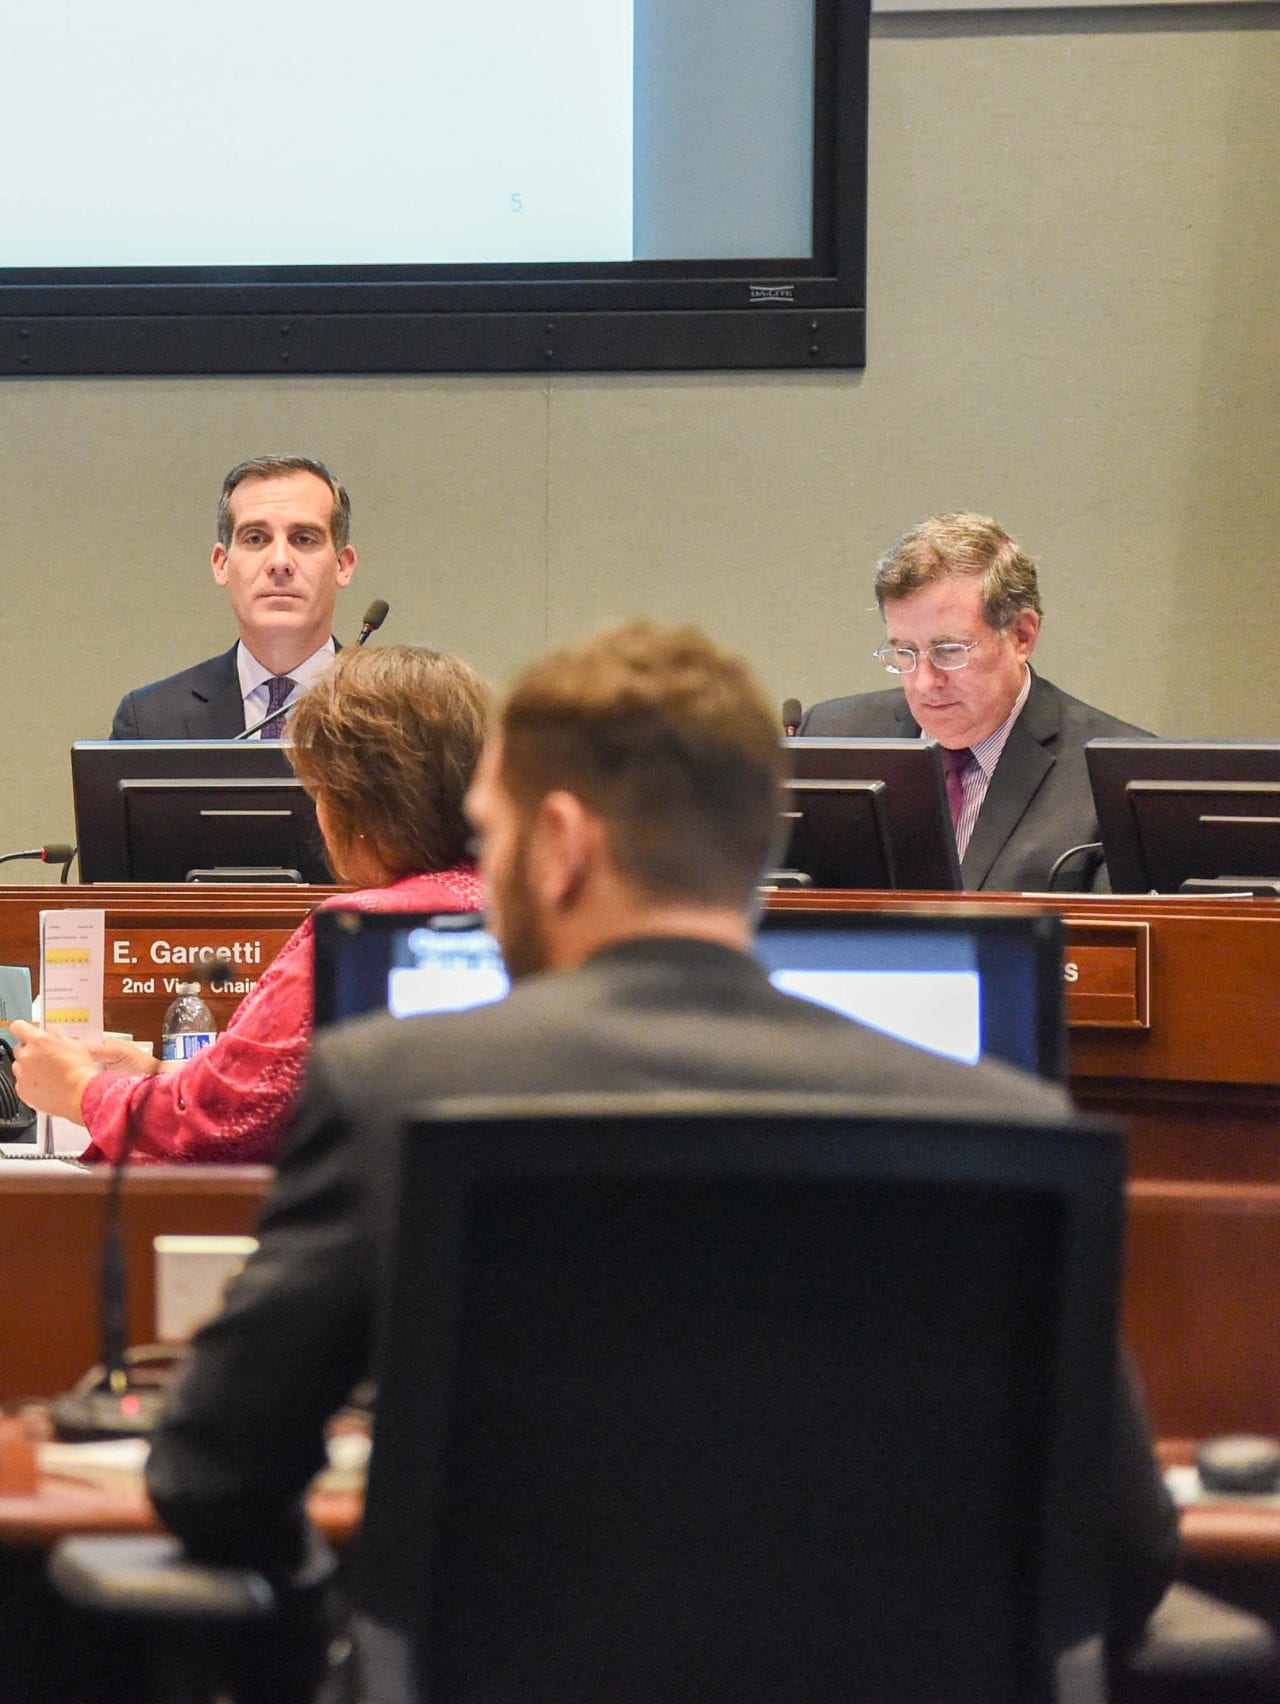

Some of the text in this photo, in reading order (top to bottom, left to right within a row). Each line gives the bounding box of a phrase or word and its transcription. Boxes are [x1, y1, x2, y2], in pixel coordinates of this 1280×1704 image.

[511, 192, 523, 213] 5
[113, 940, 261, 964] E. Garcetti
[122, 978, 257, 993] 2nd Vi Chair
